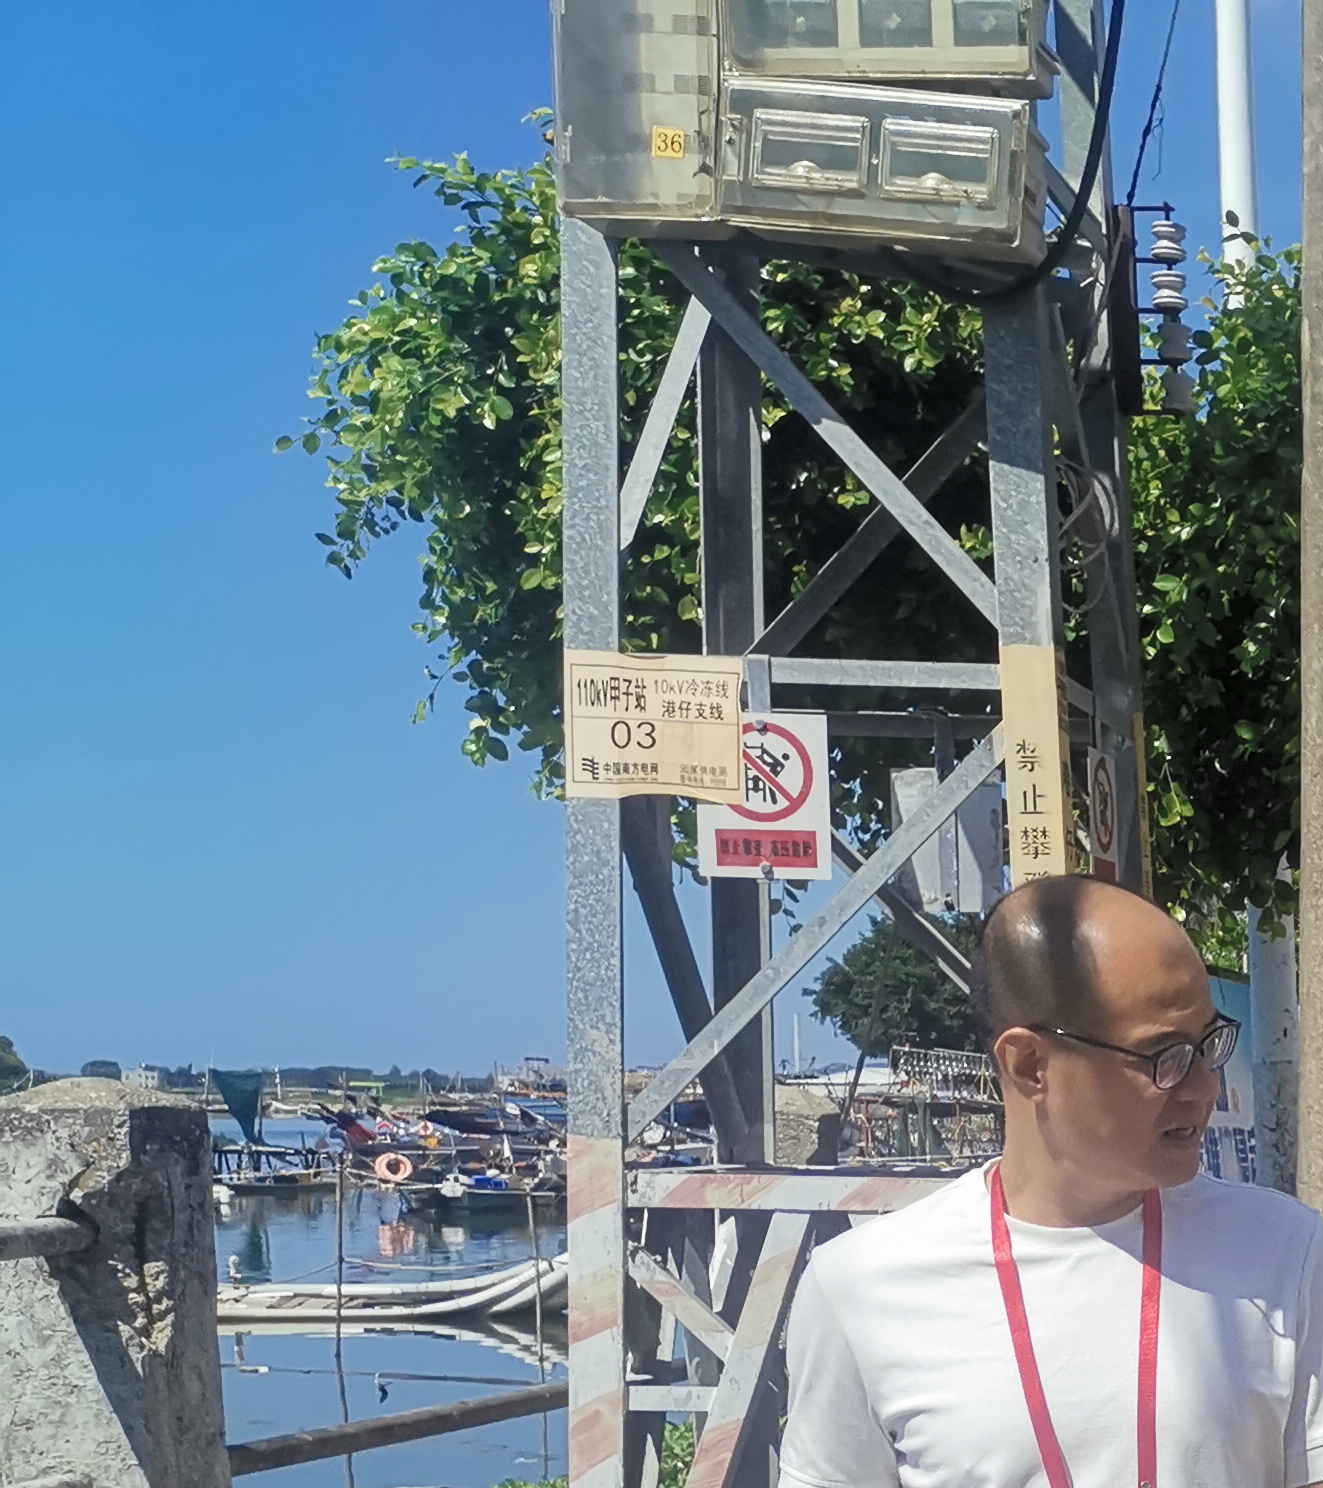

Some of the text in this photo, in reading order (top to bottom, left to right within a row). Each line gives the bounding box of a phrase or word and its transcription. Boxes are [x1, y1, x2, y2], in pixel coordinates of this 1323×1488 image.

[657, 132, 682, 153] 36
[577, 676, 647, 713] 110kV甲子站
[654, 678, 730, 699] 10kV冷冻线
[661, 699, 725, 721] 港仔支线
[610, 720, 657, 750] 03
[602, 762, 659, 776] 中国南方电网
